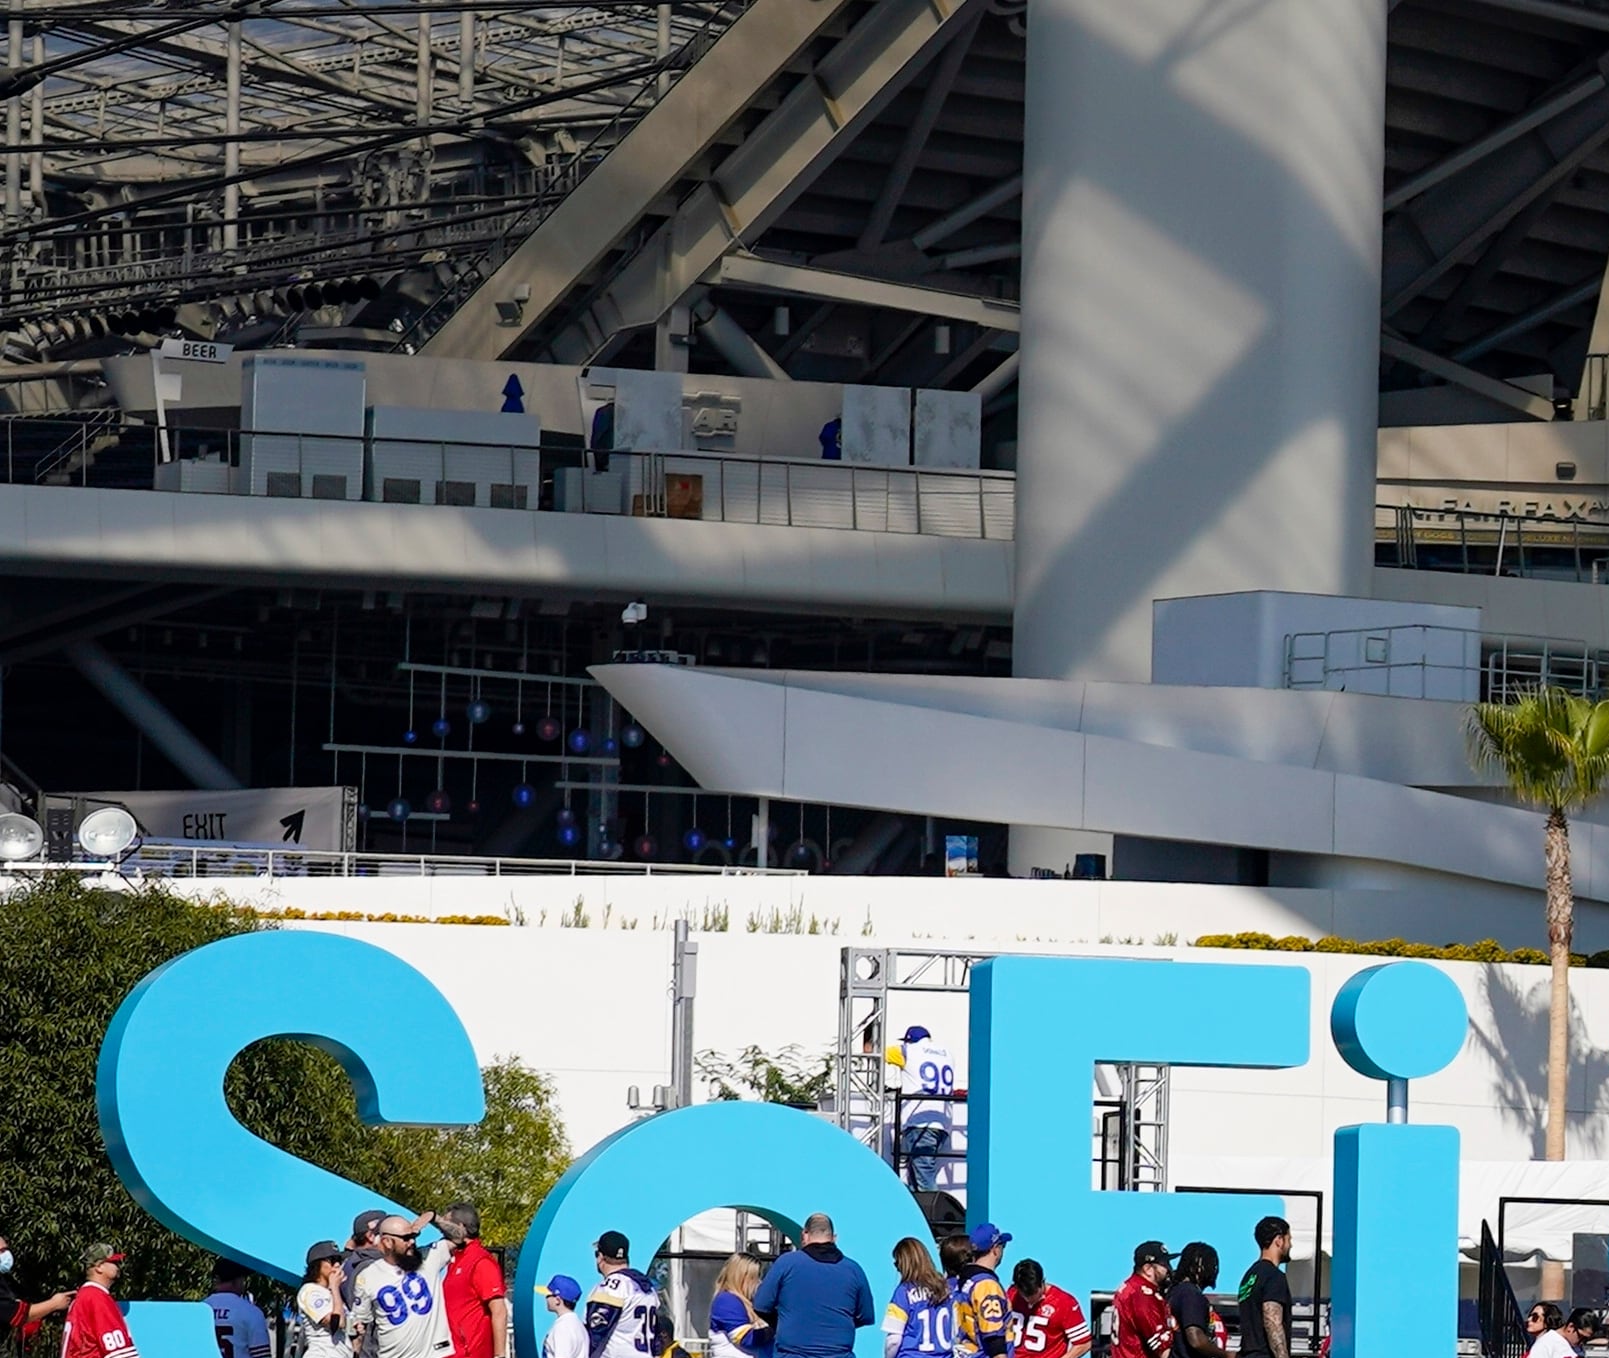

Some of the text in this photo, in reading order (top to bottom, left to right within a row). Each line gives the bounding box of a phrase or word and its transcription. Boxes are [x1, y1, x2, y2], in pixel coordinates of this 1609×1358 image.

[182, 344, 217, 358] BEER
[182, 813, 227, 840] EXIT
[919, 1061, 954, 1096] 99
[376, 1271, 432, 1326] 99
[102, 1329, 125, 1350] 80
[917, 1306, 950, 1351] 10
